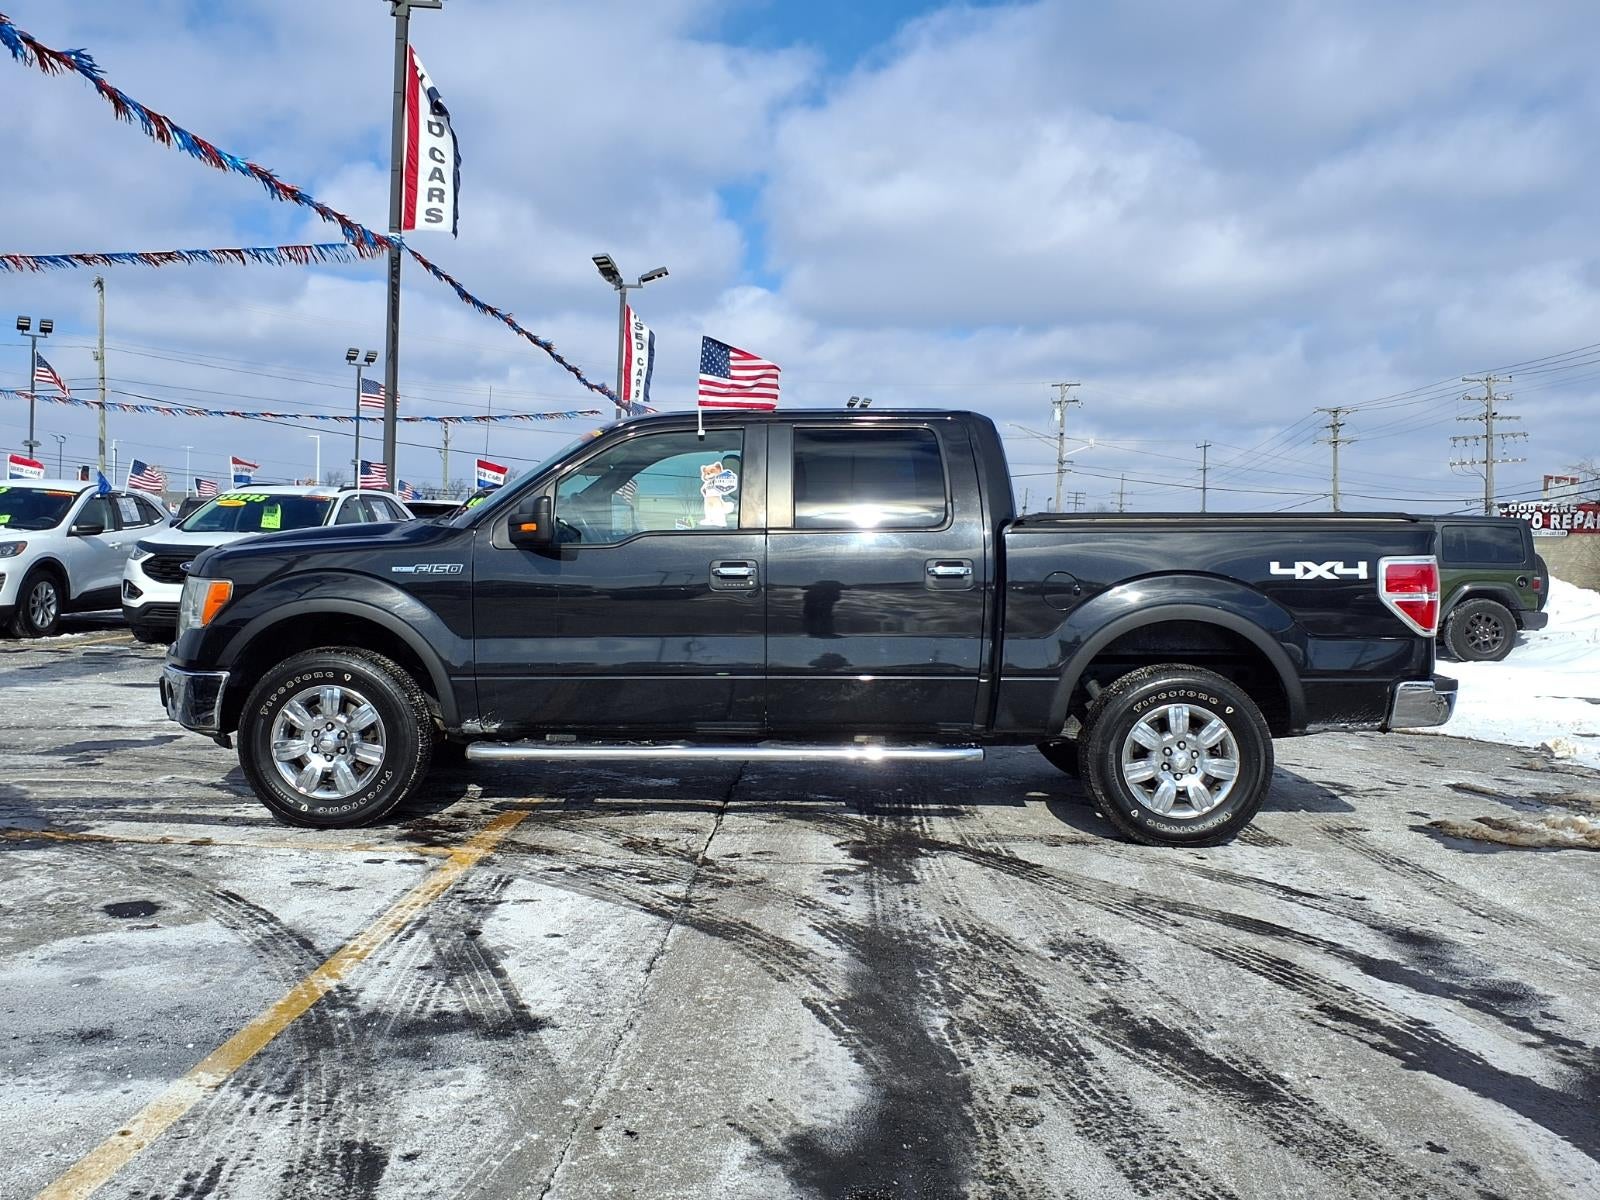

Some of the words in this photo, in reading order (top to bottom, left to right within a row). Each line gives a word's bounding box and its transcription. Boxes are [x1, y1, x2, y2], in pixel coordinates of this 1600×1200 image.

[424, 147, 446, 223] CARS
[634, 357, 645, 398] CARS
[1541, 503, 1578, 513] CARE
